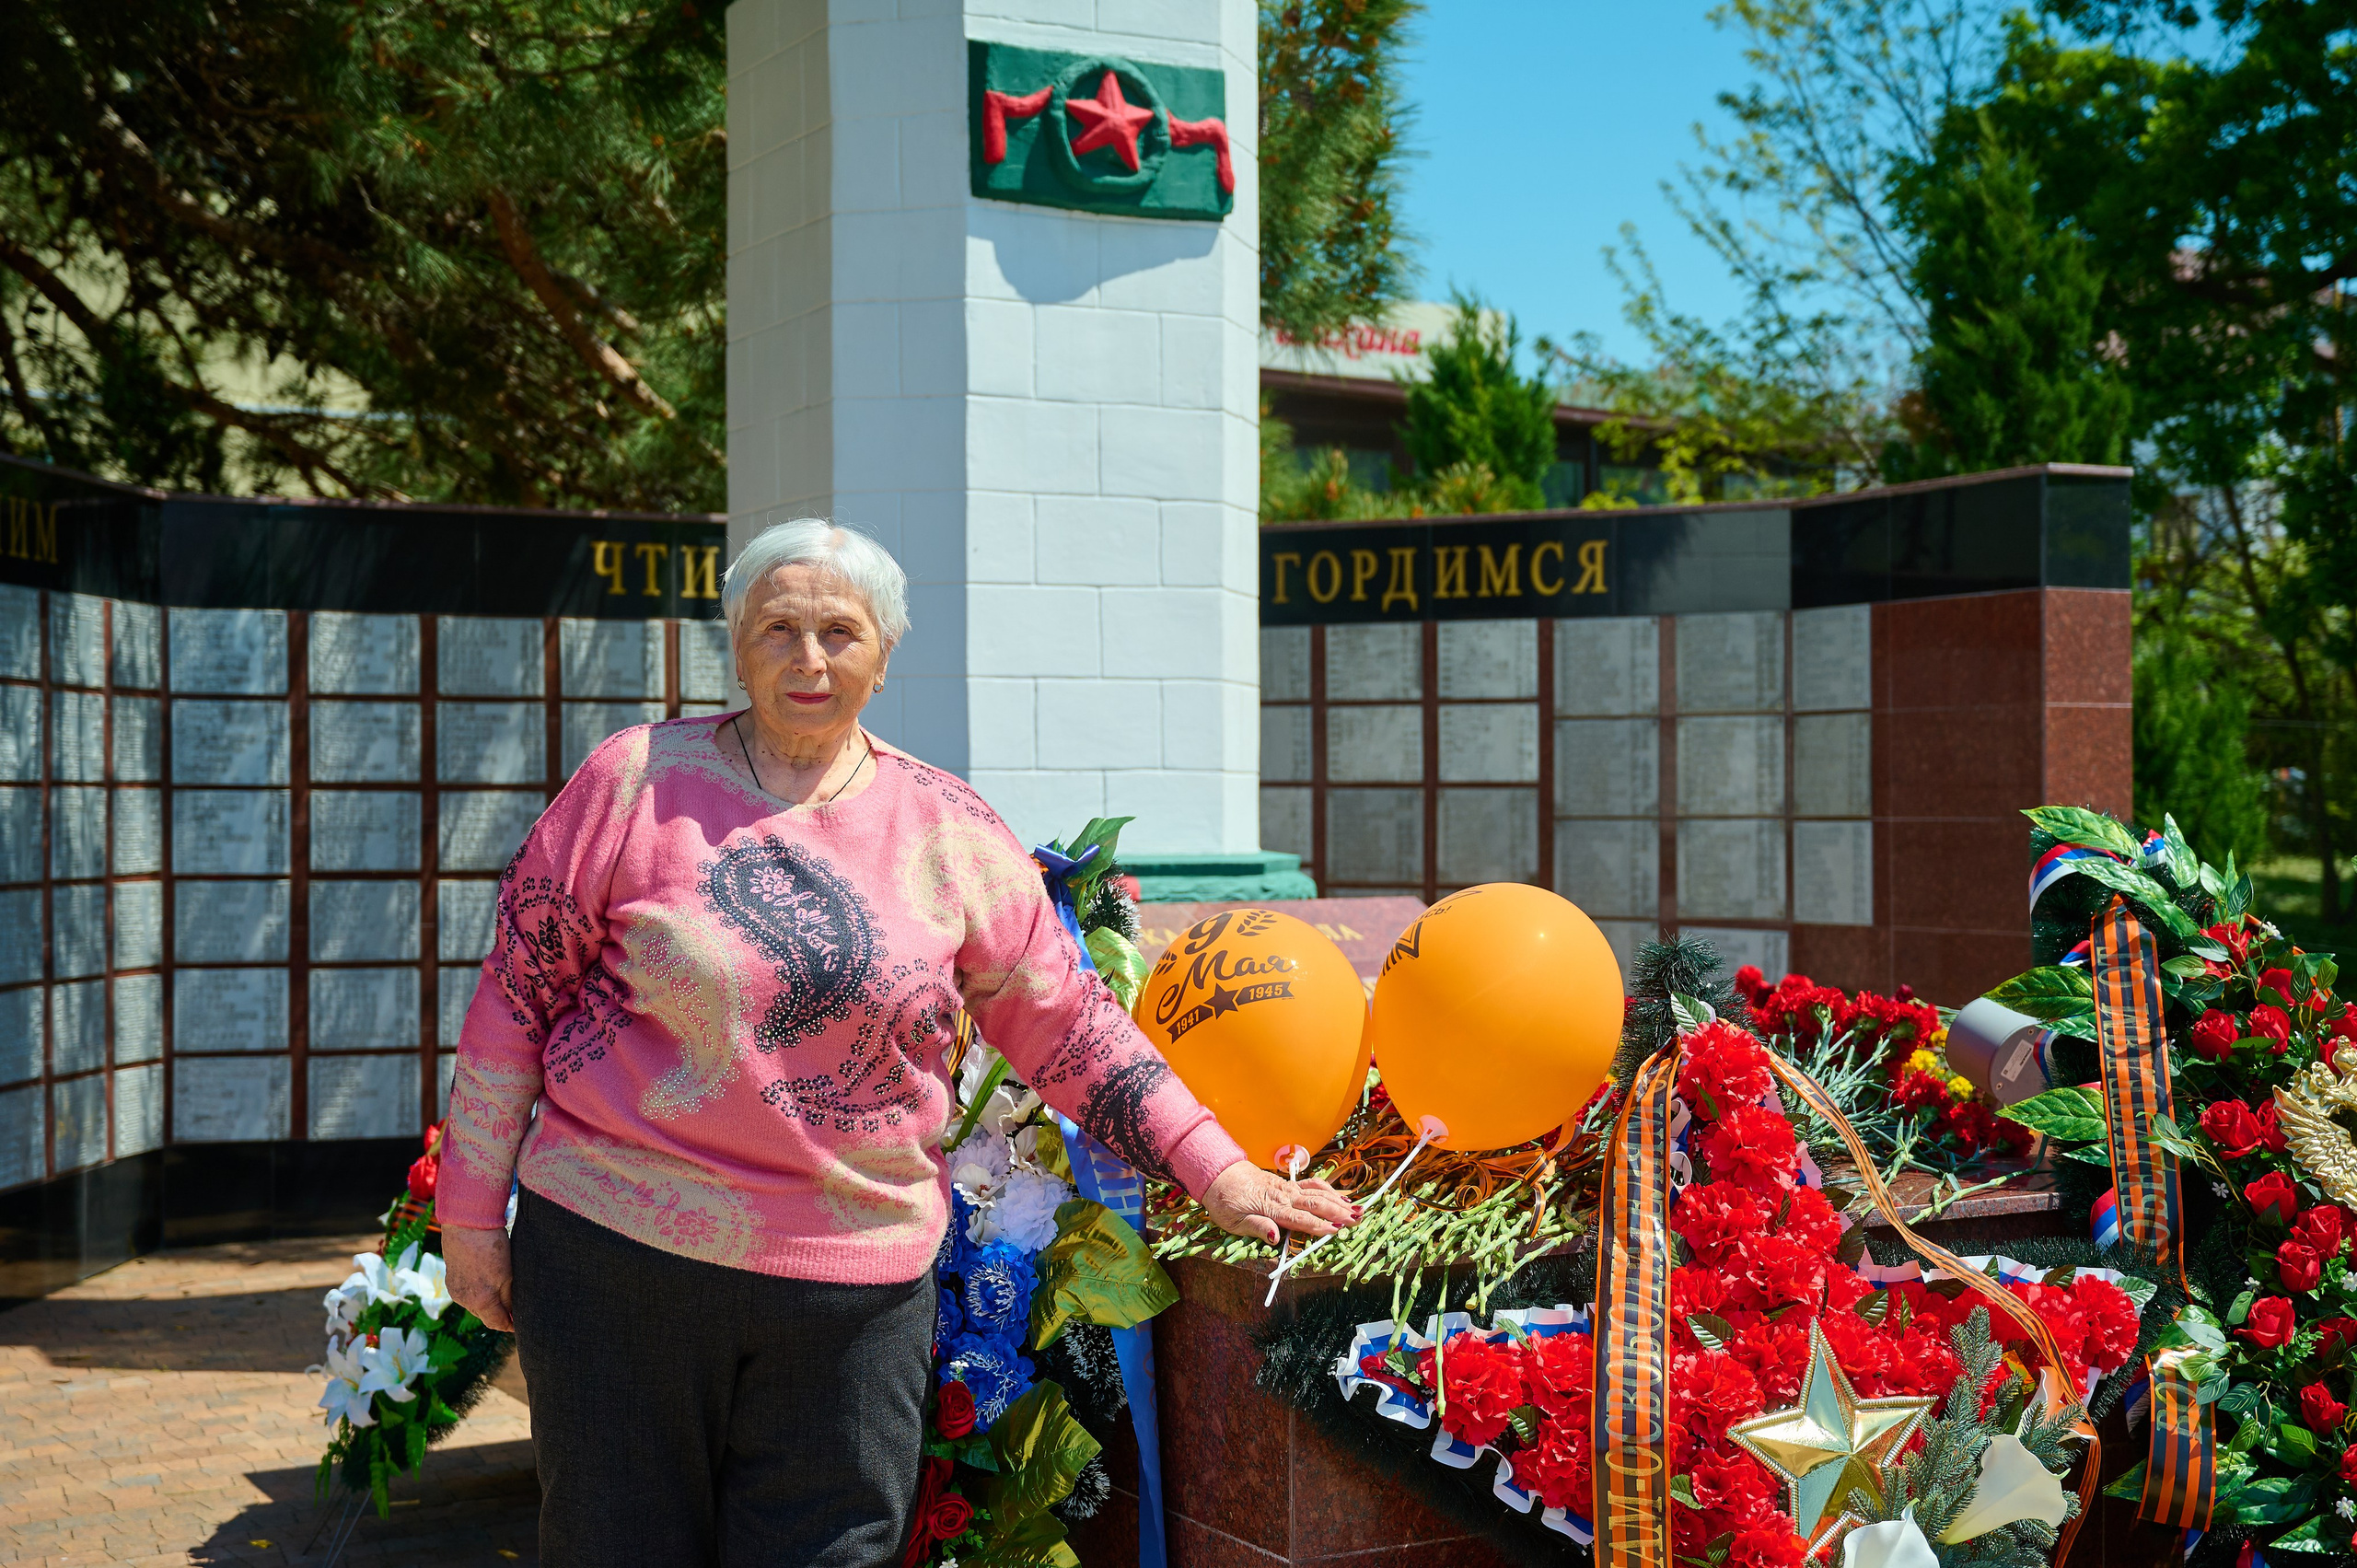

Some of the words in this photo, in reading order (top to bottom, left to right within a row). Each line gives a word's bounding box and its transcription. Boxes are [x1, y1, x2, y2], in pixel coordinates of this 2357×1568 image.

[0, 494, 58, 564] ИМ
[1271, 540, 1609, 614] ГОРДИМСЯ
[1184, 912, 1234, 955] 9
[2096, 947, 2147, 987] ОТ
[1156, 950, 1295, 1025] Мая
[1176, 1008, 1201, 1035] 1941
[1248, 984, 1283, 1002] 1945
[1604, 1103, 1666, 1568] АМ-ОСВОБОДИТЕЛЯМ
